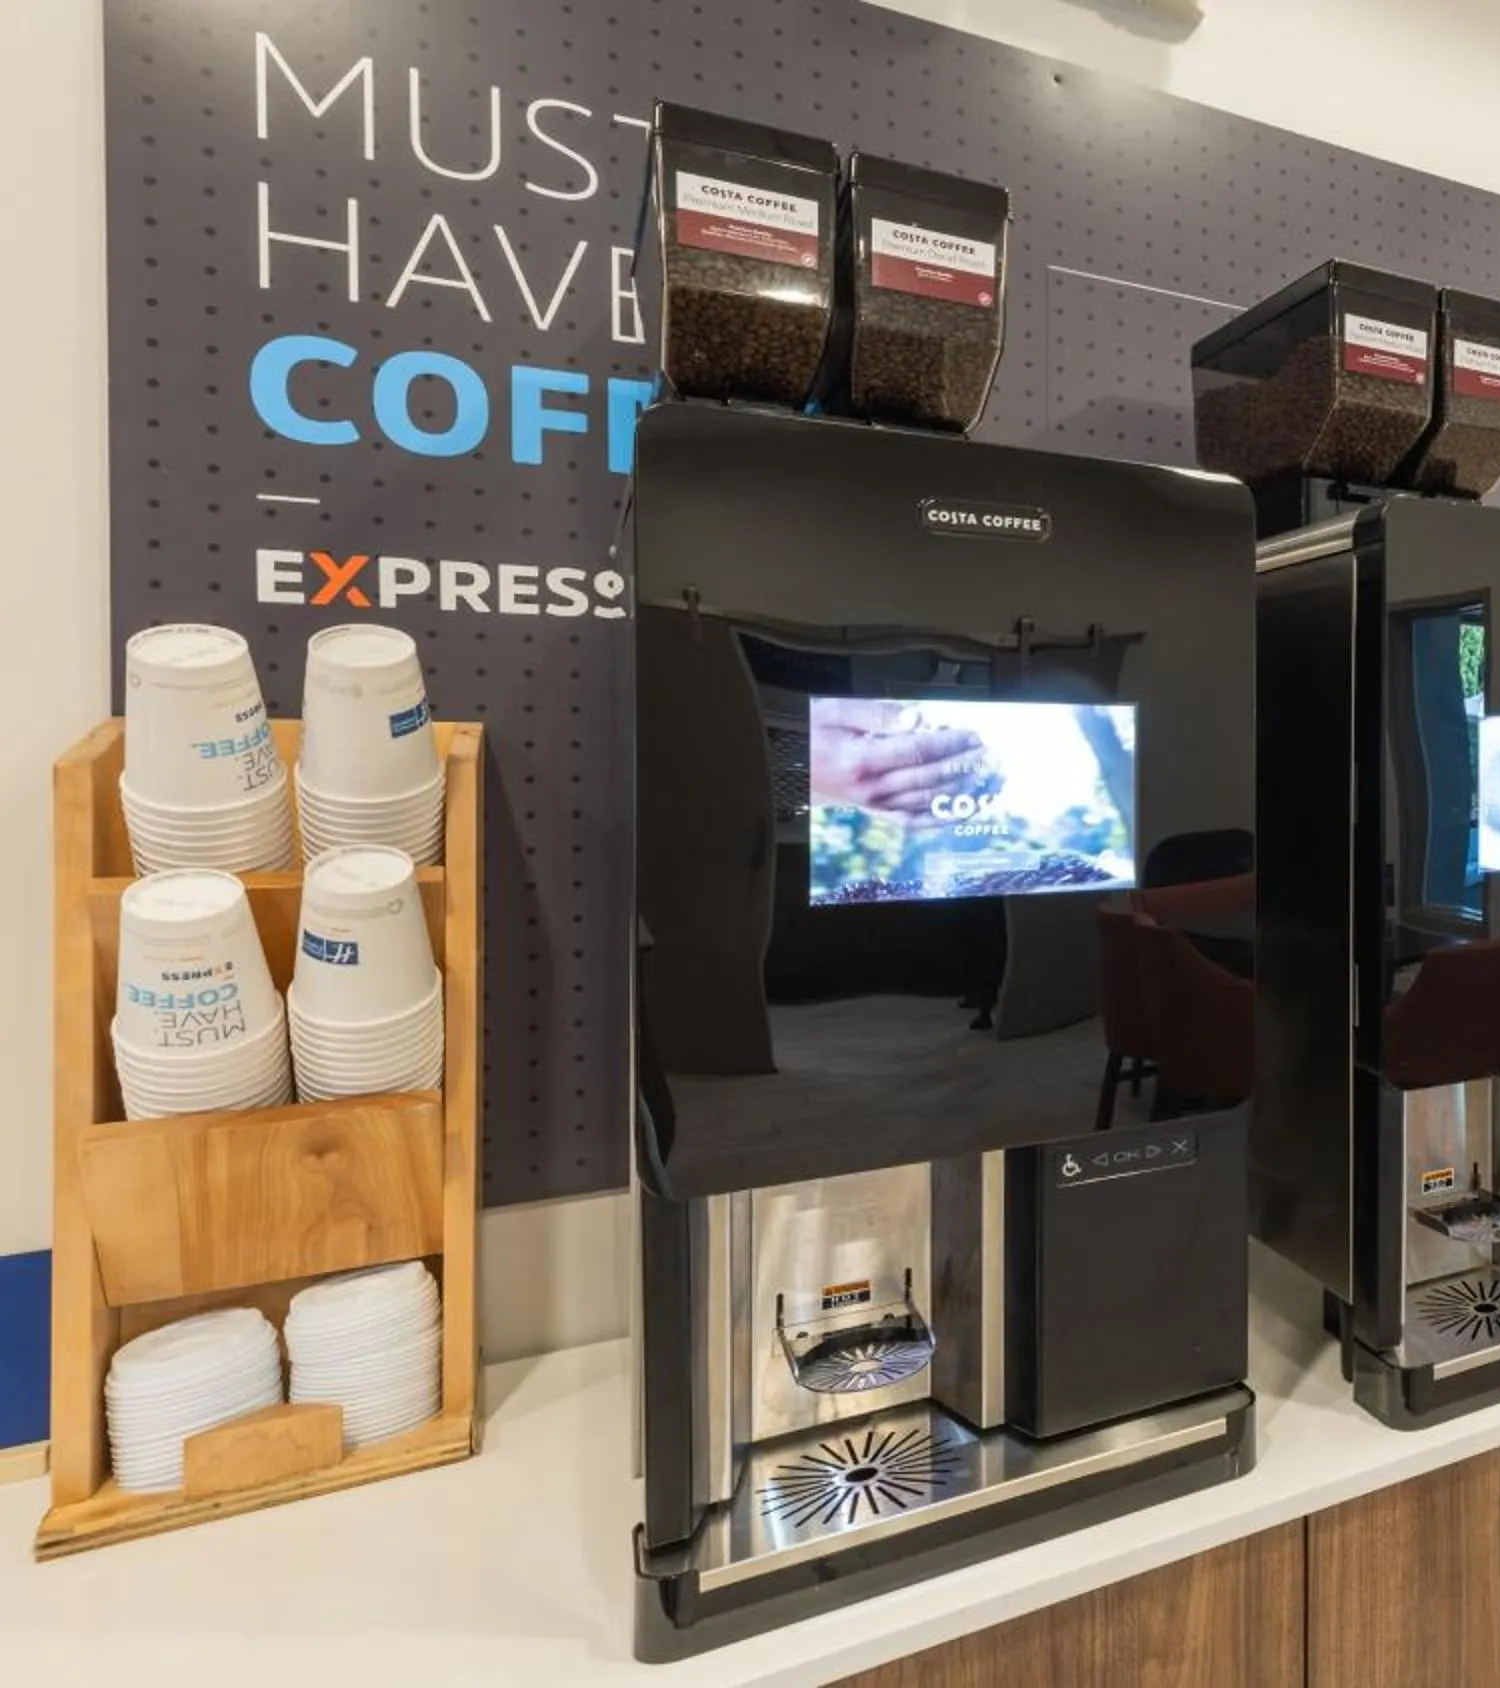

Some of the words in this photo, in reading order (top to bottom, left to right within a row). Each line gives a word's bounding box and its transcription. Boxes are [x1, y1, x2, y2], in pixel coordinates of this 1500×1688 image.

[701, 184, 743, 201] COSTA
[747, 194, 798, 213] COFFEE
[893, 229, 929, 244] COSTA
[249, 333, 653, 476] COFF
[927, 508, 977, 525] COSTA
[982, 515, 1042, 531] COFFEE
